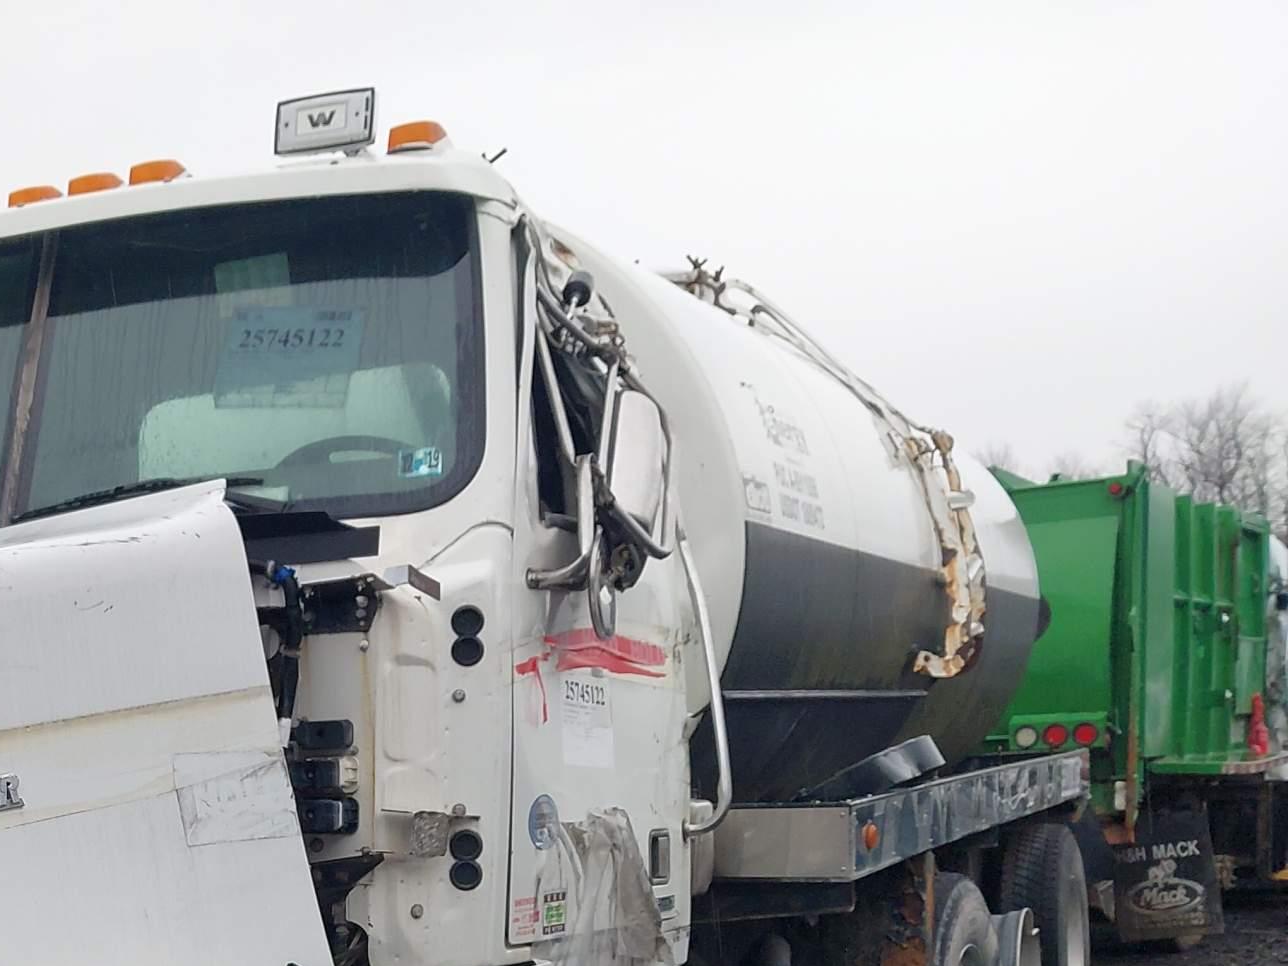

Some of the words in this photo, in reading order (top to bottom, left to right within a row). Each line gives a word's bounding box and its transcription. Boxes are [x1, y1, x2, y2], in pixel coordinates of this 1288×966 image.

[307, 109, 337, 128] W
[238, 327, 346, 352] 25745122
[564, 679, 606, 707] 25745122
[1151, 840, 1201, 860] MACK
[1139, 885, 1191, 909] Mack
